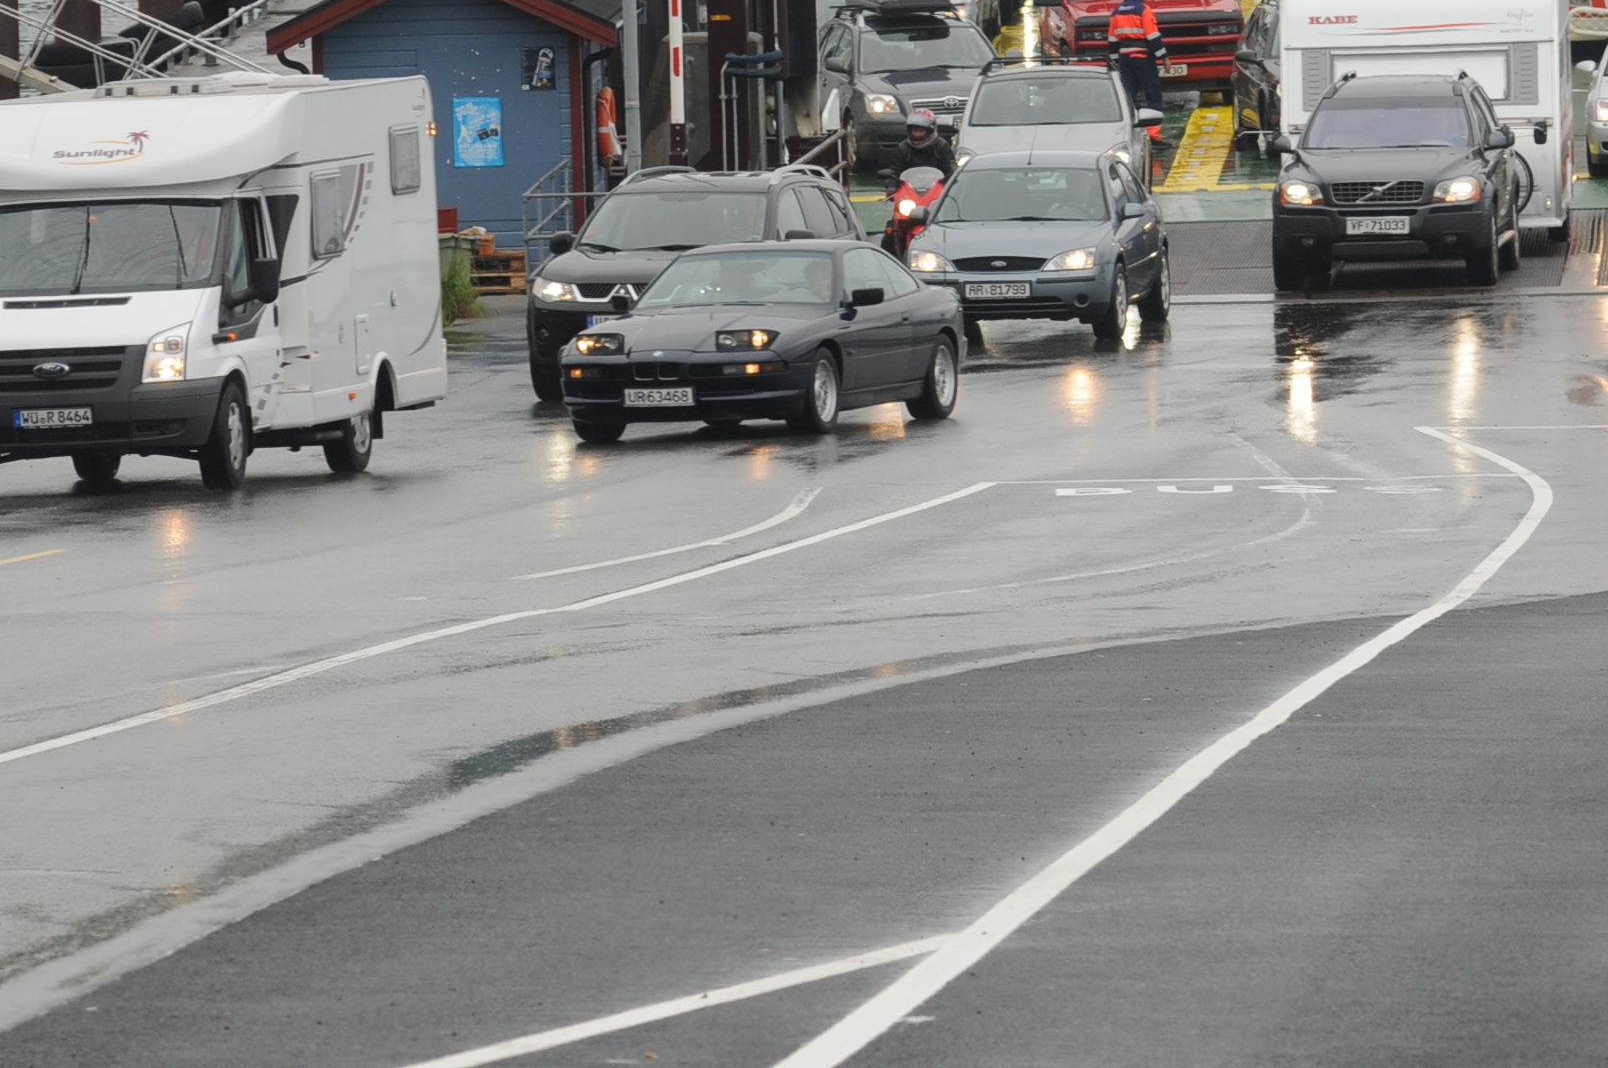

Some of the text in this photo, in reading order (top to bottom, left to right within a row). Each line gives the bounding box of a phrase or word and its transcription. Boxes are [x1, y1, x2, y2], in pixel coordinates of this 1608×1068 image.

[1308, 15, 1358, 25] KABE
[52, 148, 135, 159] Sunlight
[1351, 220, 1406, 230] VF 71033
[968, 284, 1026, 295] AR 81799
[647, 390, 689, 403] 63468
[22, 412, 39, 425] WÜ
[57, 410, 89, 424] 8464
